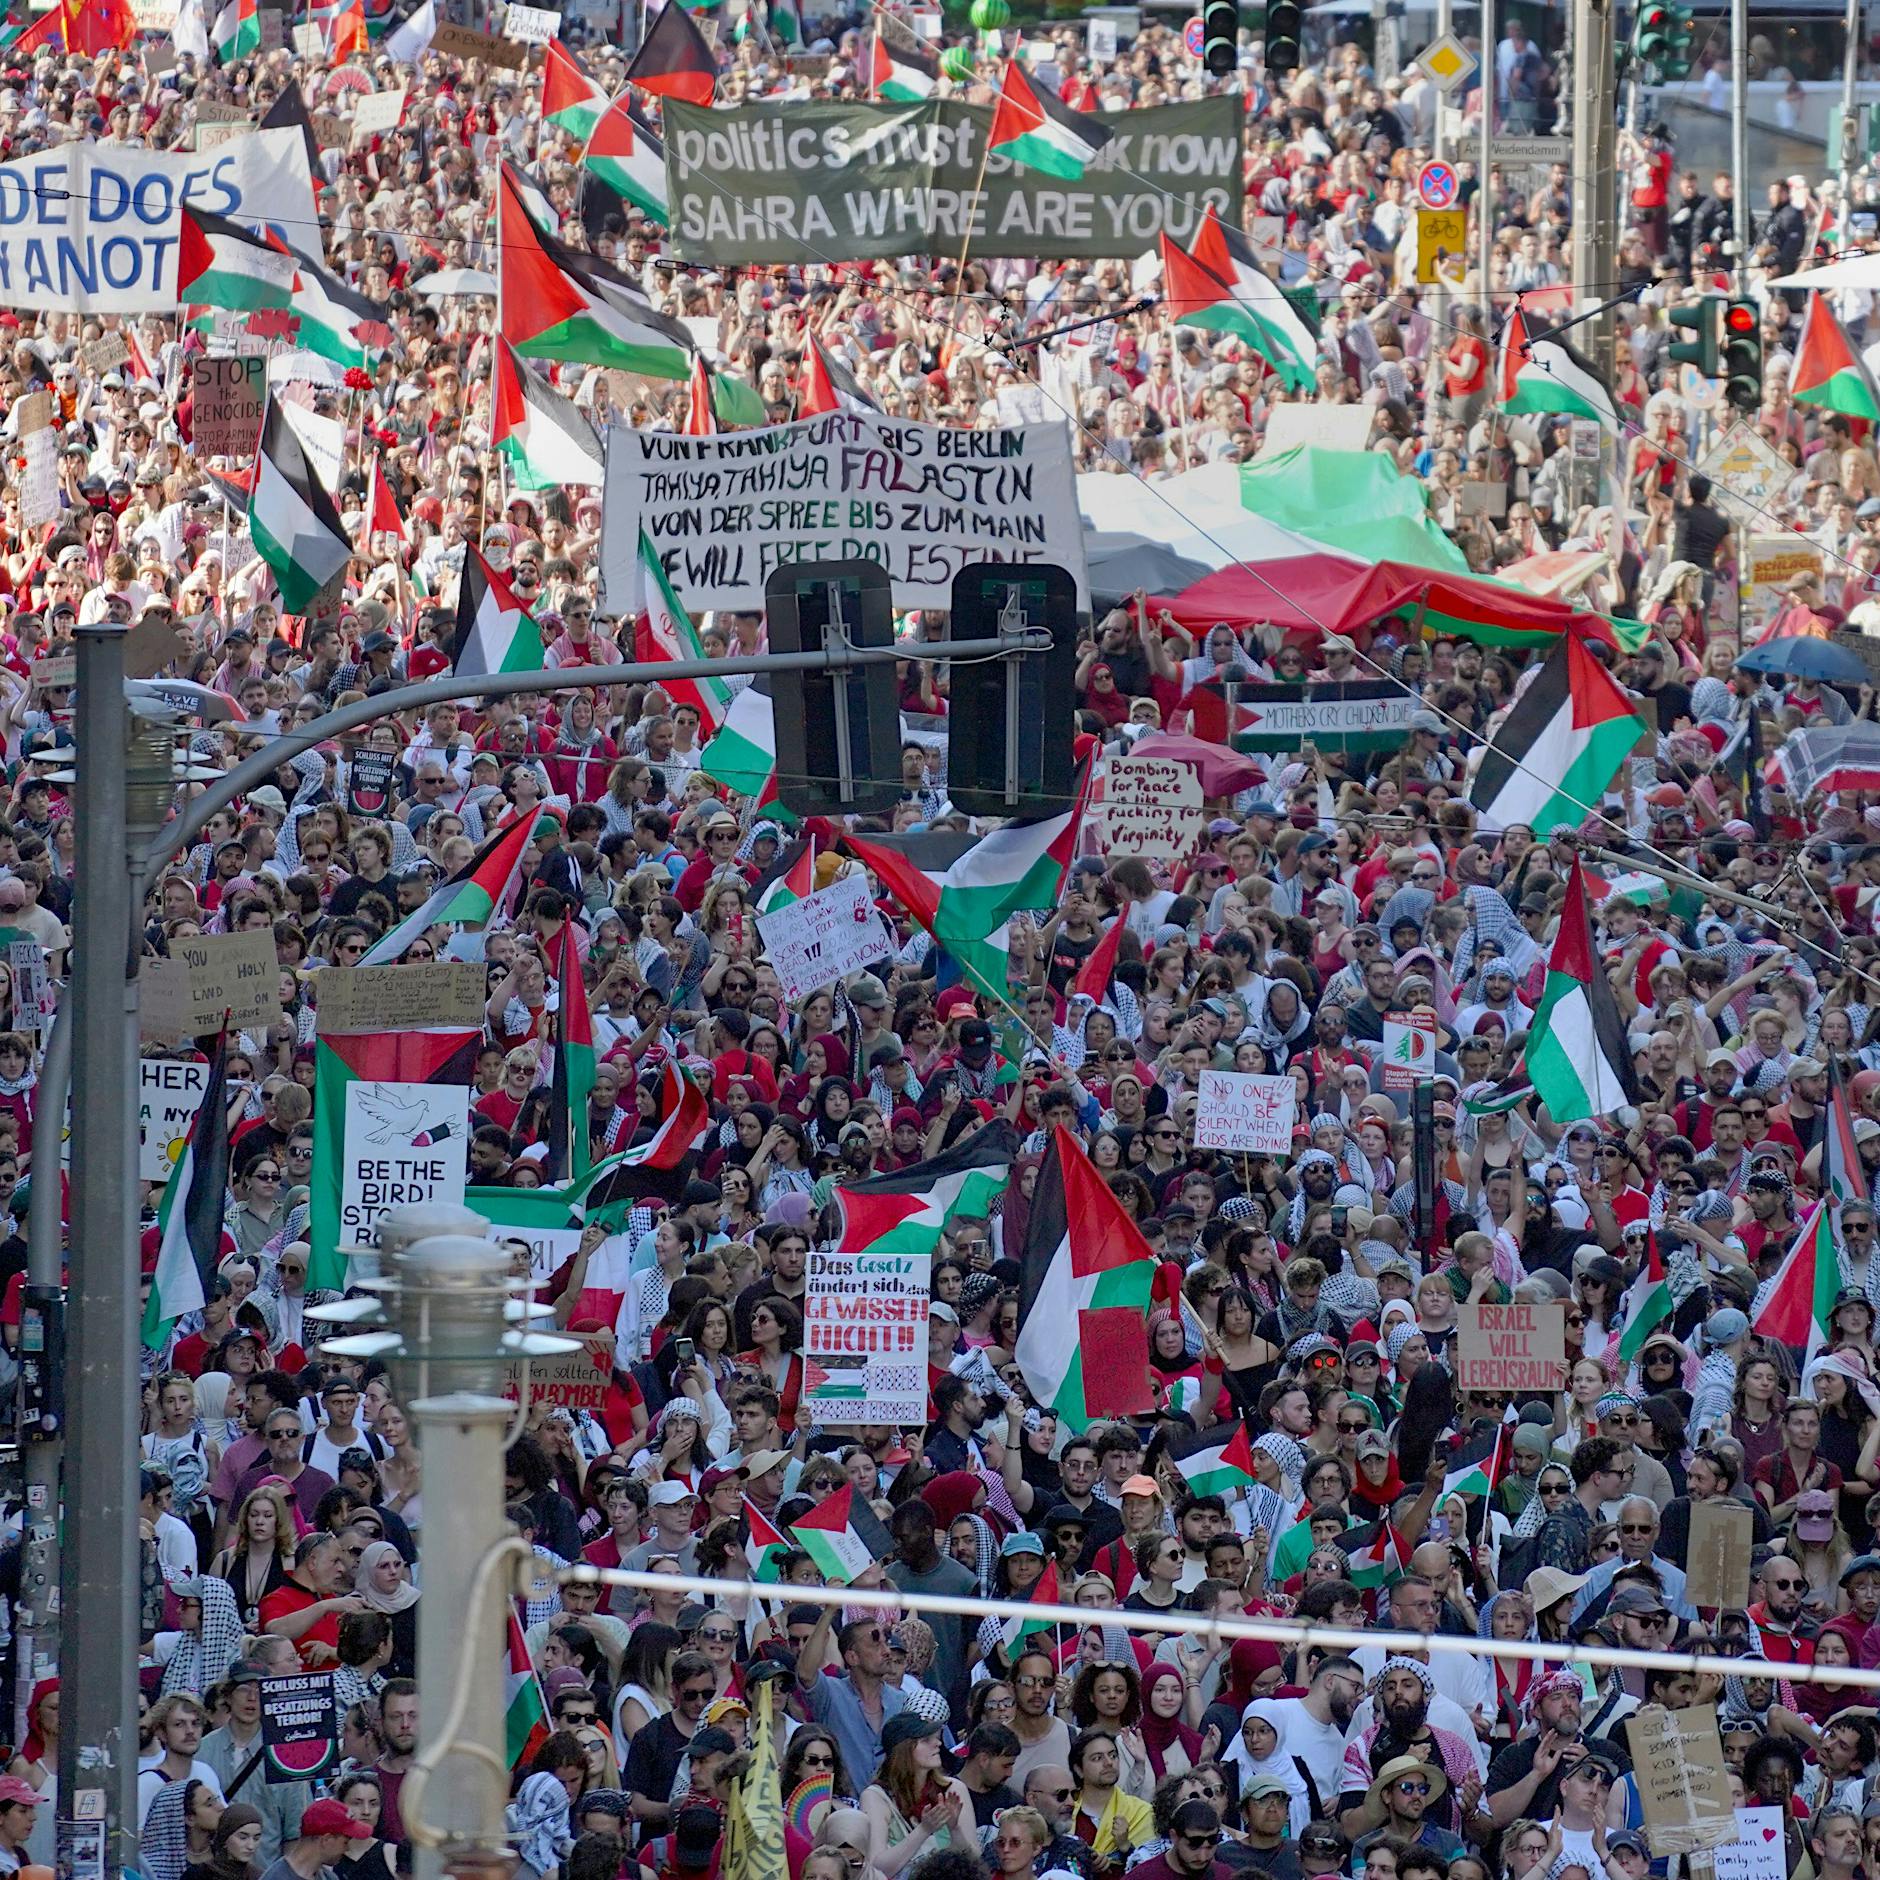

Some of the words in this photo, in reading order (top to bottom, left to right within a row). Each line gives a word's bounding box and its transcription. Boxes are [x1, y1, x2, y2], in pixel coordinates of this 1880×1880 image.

[208, 106, 240, 122] STOP
[677, 118, 851, 180] politics
[866, 116, 974, 168] must
[1140, 133, 1238, 177] now
[89, 156, 243, 226] DOES
[681, 193, 837, 241] SAHRA
[844, 186, 989, 239] WHRE
[997, 190, 1095, 238] ARE
[1102, 187, 1231, 238] YOU?
[195, 358, 264, 386] STOP
[218, 387, 238, 401] the
[194, 400, 263, 424] GENOCIDE
[195, 430, 226, 443] STOP
[640, 434, 692, 461] VON
[696, 414, 865, 459] FRANKFURT
[878, 424, 924, 457] BIS
[937, 429, 1027, 458] BERLIN
[723, 451, 829, 497] TAHIYA
[840, 446, 1034, 506] FALASTIN
[651, 508, 701, 537] VON
[711, 503, 753, 534] DER
[758, 499, 840, 531] SPREE
[849, 500, 894, 530] BIS
[900, 502, 966, 535] ZUM
[972, 507, 1047, 543] MAIN
[685, 543, 751, 590] WILL
[1265, 706, 1316, 729] MOTHERS
[1320, 704, 1341, 727] CRY
[1346, 702, 1389, 725] CHILDREN
[1392, 703, 1409, 723] DIE
[355, 751, 380, 761] SCHLUSS
[381, 754, 393, 762] MIT
[354, 764, 391, 776] BESATZUNGS
[359, 773, 385, 784] TERROR!
[1111, 760, 1178, 782] Bombing
[1112, 779, 1132, 792] for
[1134, 777, 1182, 794] Peace
[1117, 793, 1128, 805] is
[1135, 793, 1159, 805] like
[1112, 824, 1185, 853] Virginity
[830, 881, 854, 898] KIDS
[815, 920, 837, 936] FOOD
[183, 950, 207, 968] YOU
[803, 965, 841, 990] SPEAKING
[842, 956, 855, 969] UP
[853, 934, 891, 964] NOW?
[238, 962, 266, 979] HOLY
[193, 987, 223, 1001] LAND
[255, 992, 269, 1004] ON
[194, 1014, 214, 1025] THE
[142, 1064, 203, 1091] HER
[1214, 1079, 1234, 1095] NO
[1242, 1083, 1274, 1100] ONE
[1201, 1101, 1249, 1118] SHOULD
[1255, 1103, 1276, 1118] BE
[1197, 1116, 1241, 1130] SILENT
[1245, 1119, 1285, 1134] WHEN
[1199, 1131, 1228, 1147] KIDS
[1231, 1133, 1253, 1148] ARE
[1256, 1136, 1289, 1150] DYING
[358, 1160, 389, 1180] BE
[395, 1160, 446, 1181] THE
[362, 1183, 433, 1204] BIRD!
[810, 1254, 853, 1276] Das
[808, 1278, 868, 1294] ändert
[873, 1277, 905, 1293] sich
[805, 1296, 929, 1322] GEWISSEN
[1478, 1306, 1537, 1331] ISRAEL
[811, 1324, 915, 1352] NICHT!!
[1489, 1333, 1532, 1357] WILL
[553, 1363, 600, 1381] sollten
[1460, 1359, 1563, 1388] LEBENSRAUM
[261, 1678, 308, 1694] SCHLUSS
[310, 1675, 331, 1689] MIT
[264, 1698, 333, 1716] BESATZUNGS
[275, 1711, 322, 1727] TERROR!
[1720, 1839, 1757, 1848] uman
[1714, 1853, 1753, 1868] amily,
